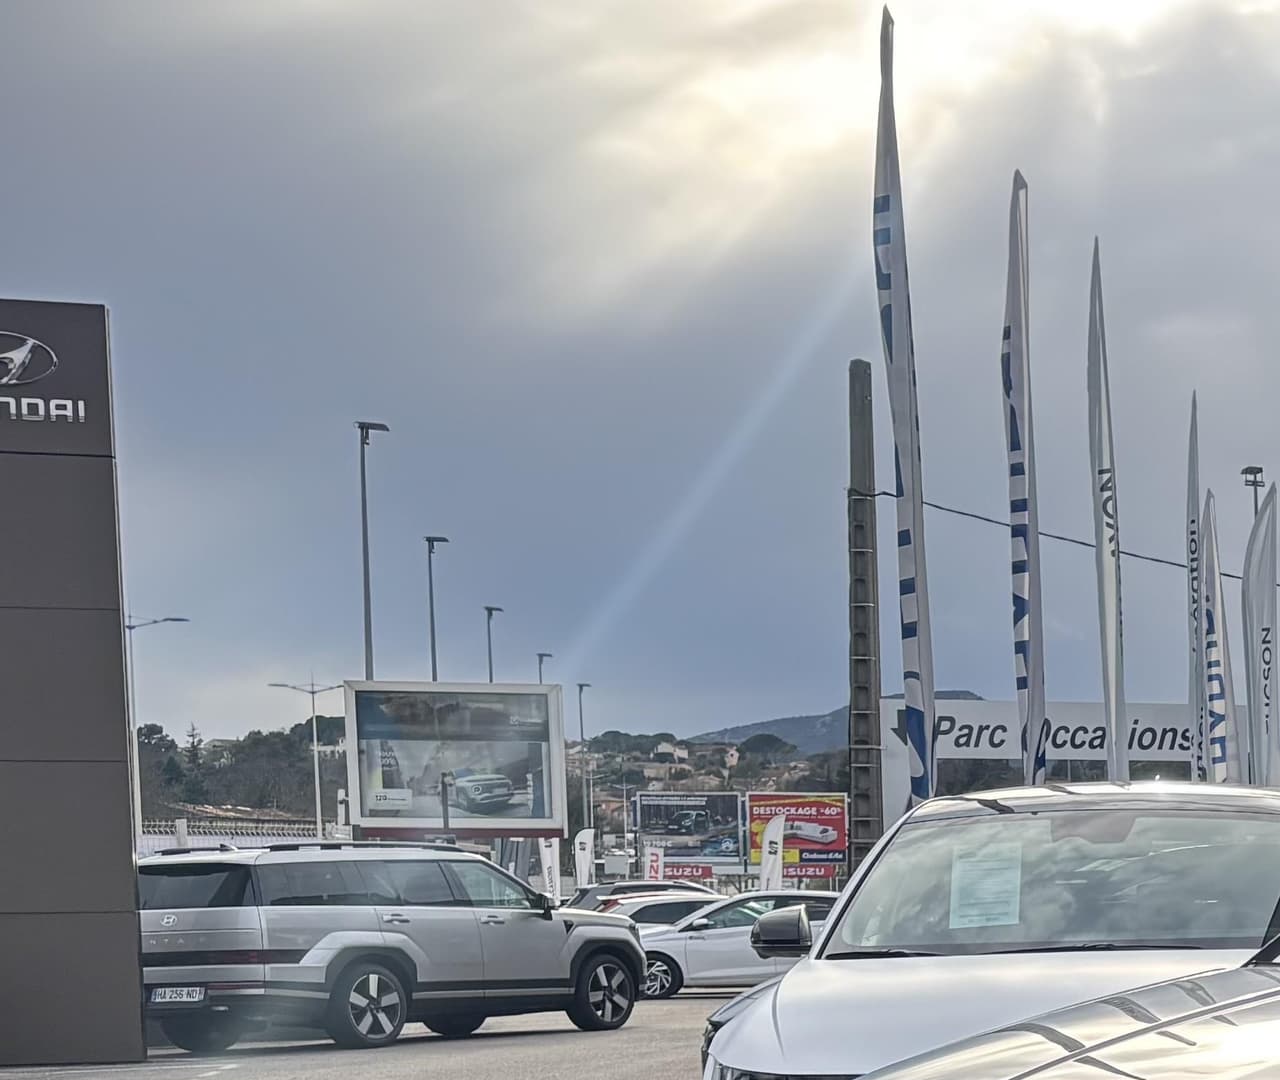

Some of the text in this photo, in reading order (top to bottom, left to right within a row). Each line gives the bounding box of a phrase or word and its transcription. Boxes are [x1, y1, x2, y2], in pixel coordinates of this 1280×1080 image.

[933, 715, 1008, 749] Parc
[1021, 717, 1194, 752] ccaions
[752, 806, 818, 816] DESTOCKAGE
[664, 867, 703, 876] SUZU
[784, 867, 825, 876] ISUZU
